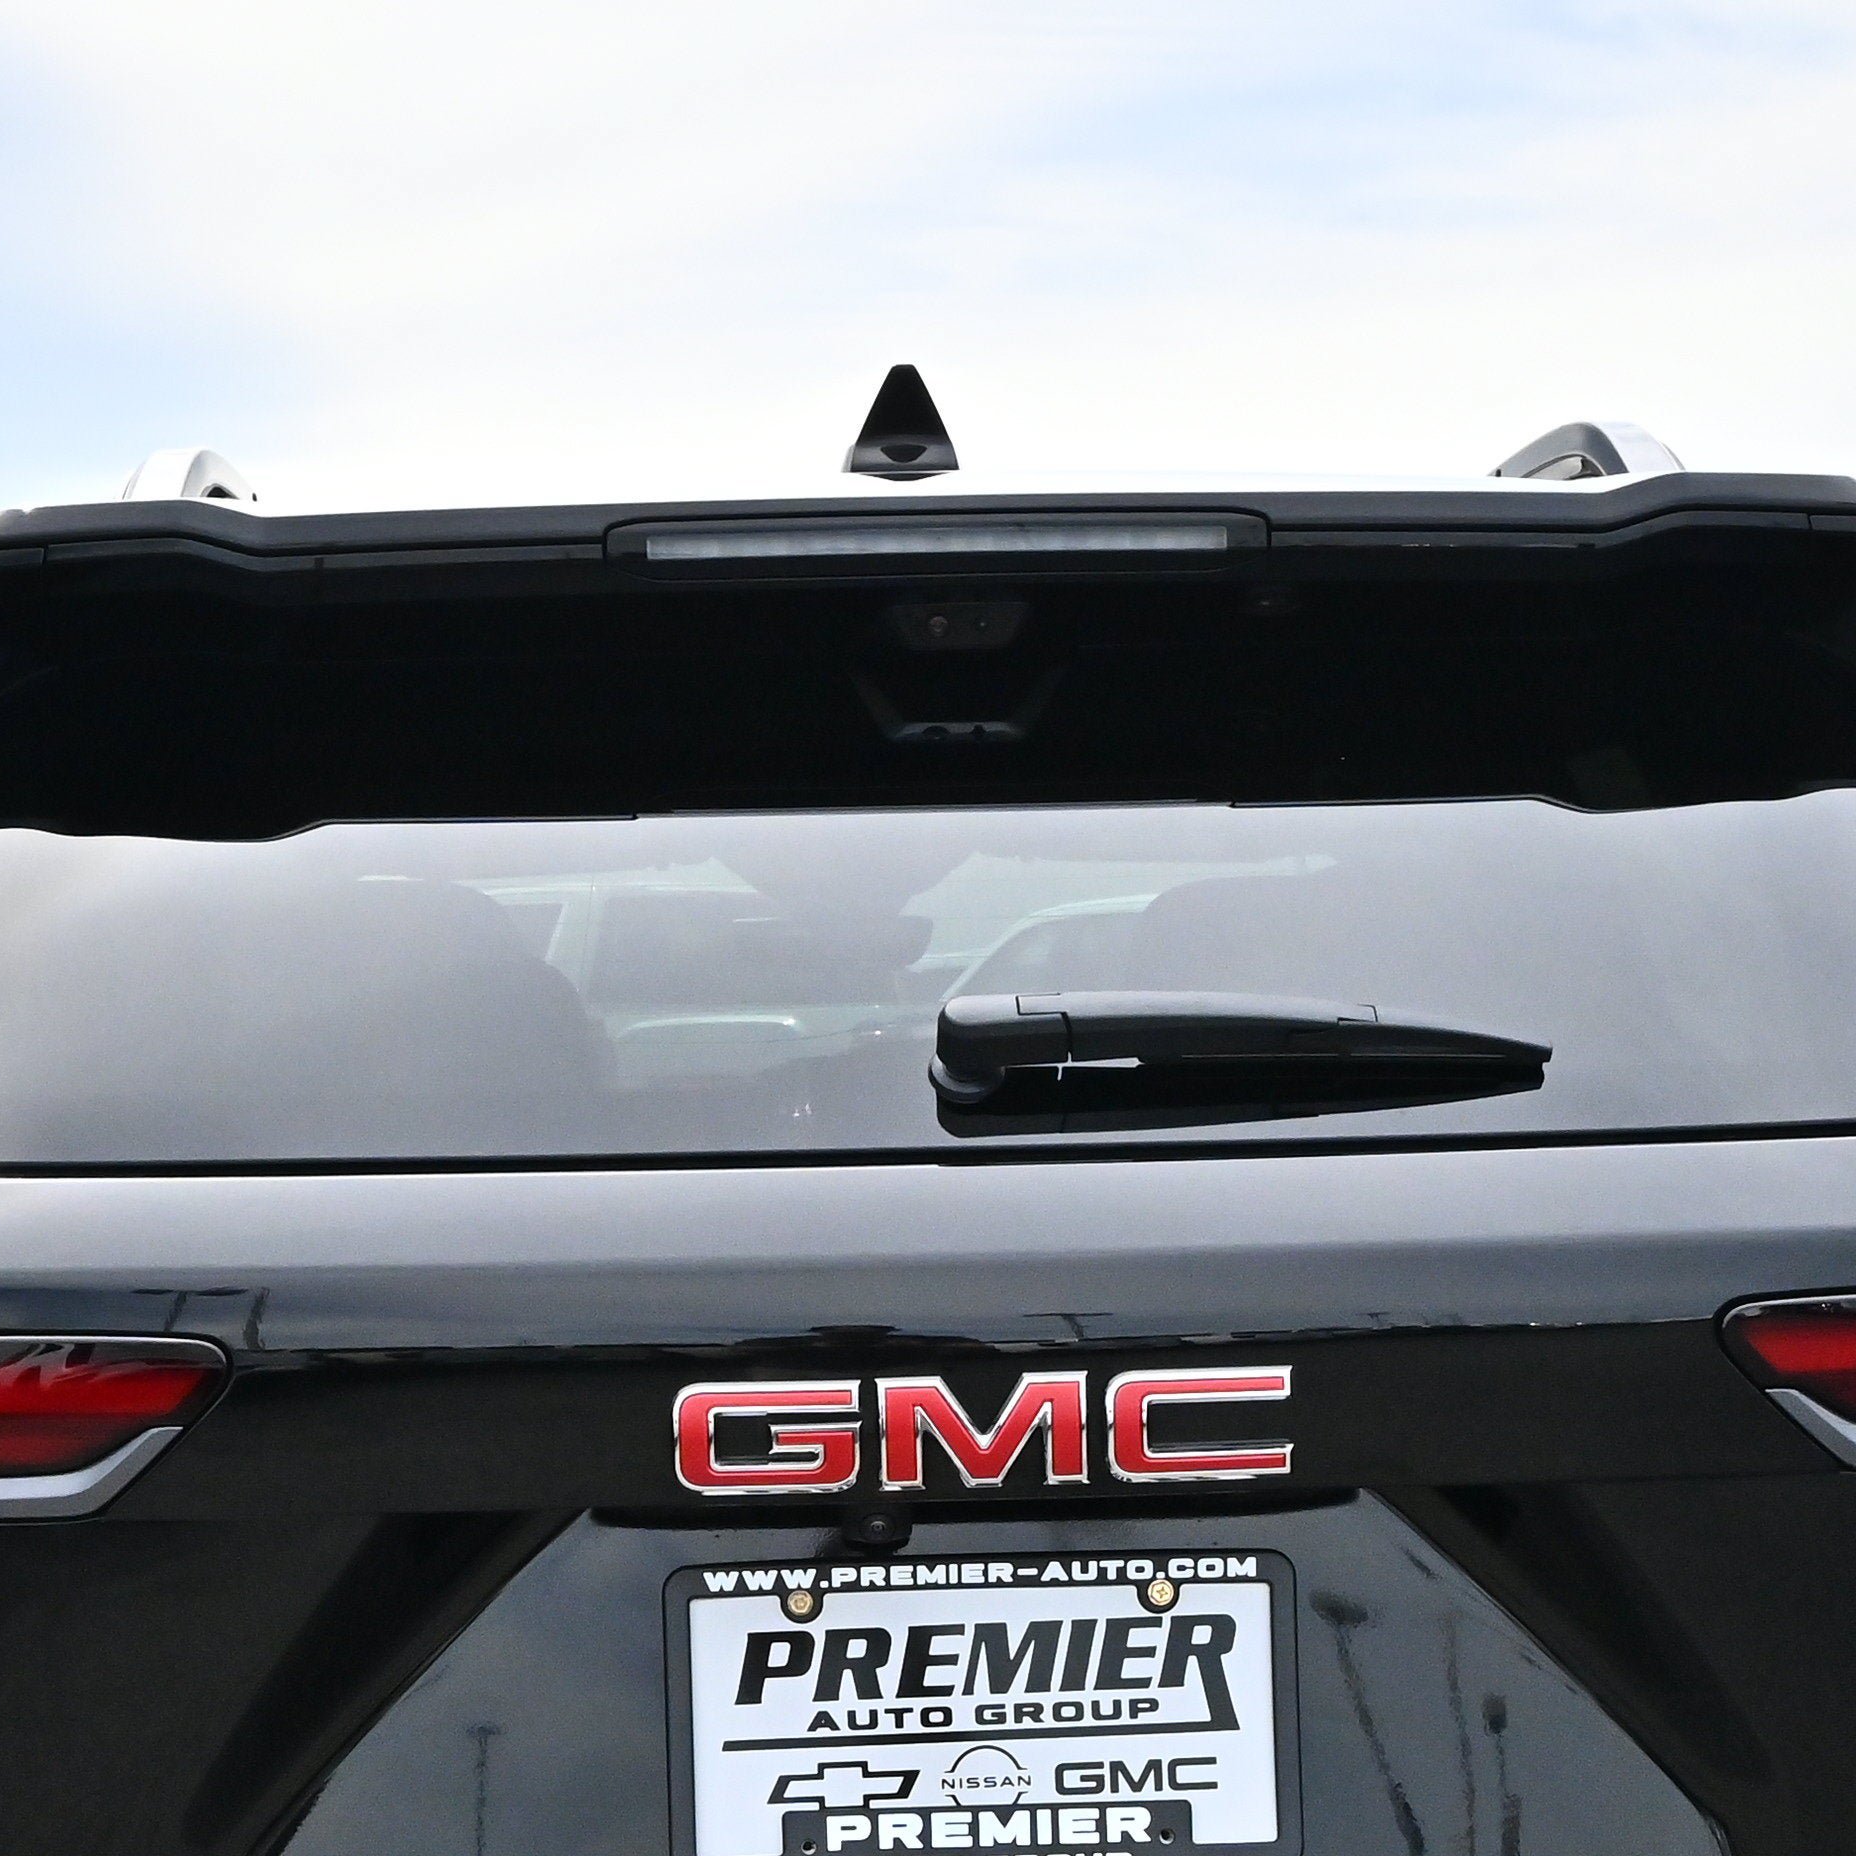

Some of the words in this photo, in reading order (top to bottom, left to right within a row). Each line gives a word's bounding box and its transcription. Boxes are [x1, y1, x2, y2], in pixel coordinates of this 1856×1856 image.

[672, 1364, 1294, 1496] GMC
[702, 1556, 1258, 1593] WWW.PREMIER-AUTO.COM
[734, 1613, 1240, 1730] PREMIER
[807, 1706, 954, 1732] AUTO
[974, 1698, 1160, 1726] GROUP
[941, 1774, 1032, 1790] NISSAN
[1054, 1757, 1219, 1796] GMC
[826, 1805, 1152, 1852] PREMIER
